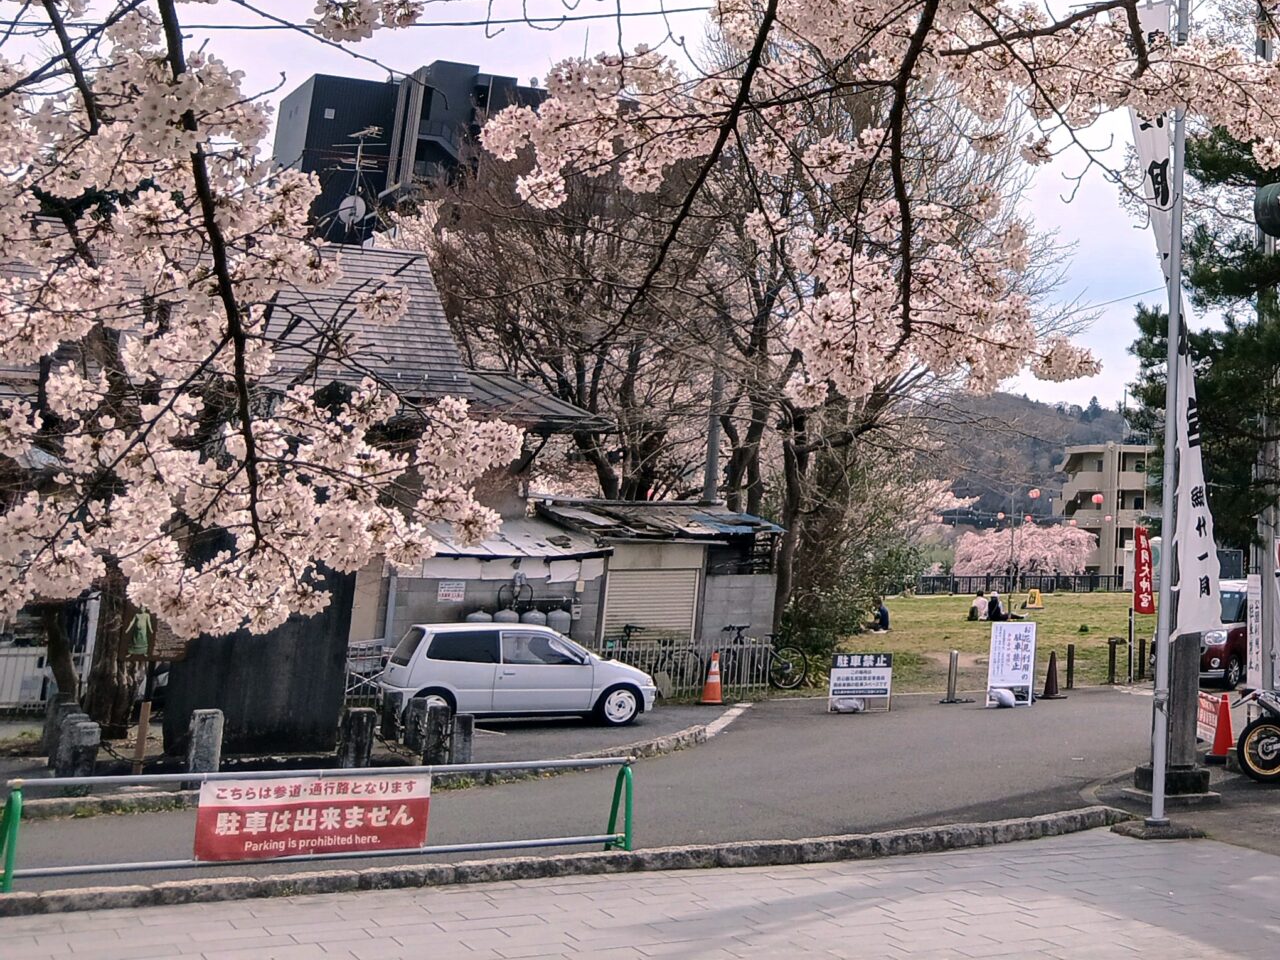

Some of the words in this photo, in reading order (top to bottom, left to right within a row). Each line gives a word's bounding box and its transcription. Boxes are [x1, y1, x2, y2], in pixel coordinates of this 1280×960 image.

[836, 654, 888, 668] 駐車禁止
[1011, 632, 1022, 671] 駐車禁止
[215, 780, 417, 801] こちらは参道・通行路となります
[214, 804, 415, 836] 駐車は出来ません
[244, 839, 286, 852] Parking
[287, 837, 297, 848] is
[298, 835, 353, 849] prohibited
[354, 834, 381, 845] here.
